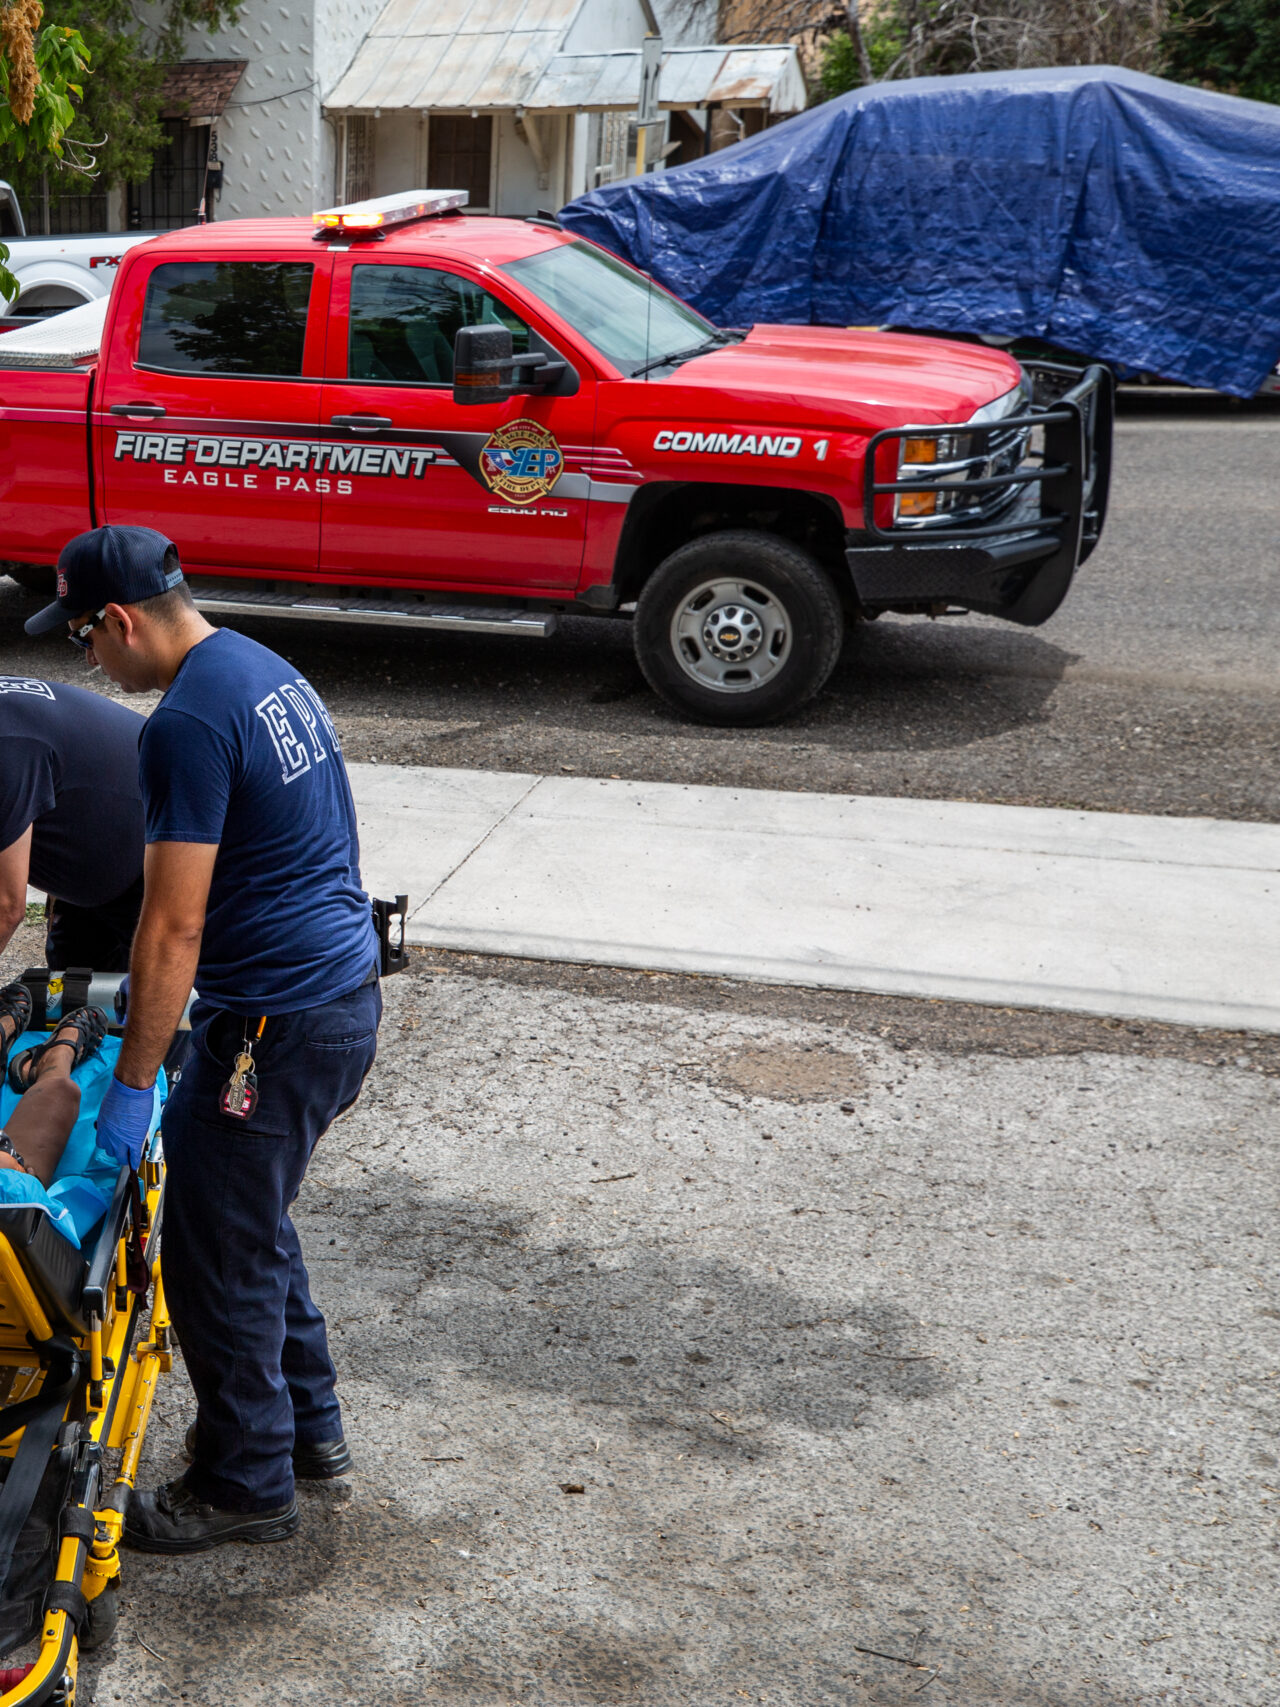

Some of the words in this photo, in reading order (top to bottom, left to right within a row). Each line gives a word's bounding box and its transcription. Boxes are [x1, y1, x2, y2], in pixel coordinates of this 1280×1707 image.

[114, 434, 186, 462] FIRE
[195, 439, 434, 477] DEPARTMENT
[653, 430, 802, 457] COMMAND
[813, 439, 829, 461] 1
[164, 469, 258, 489] EAGLE
[276, 476, 353, 495] PASS
